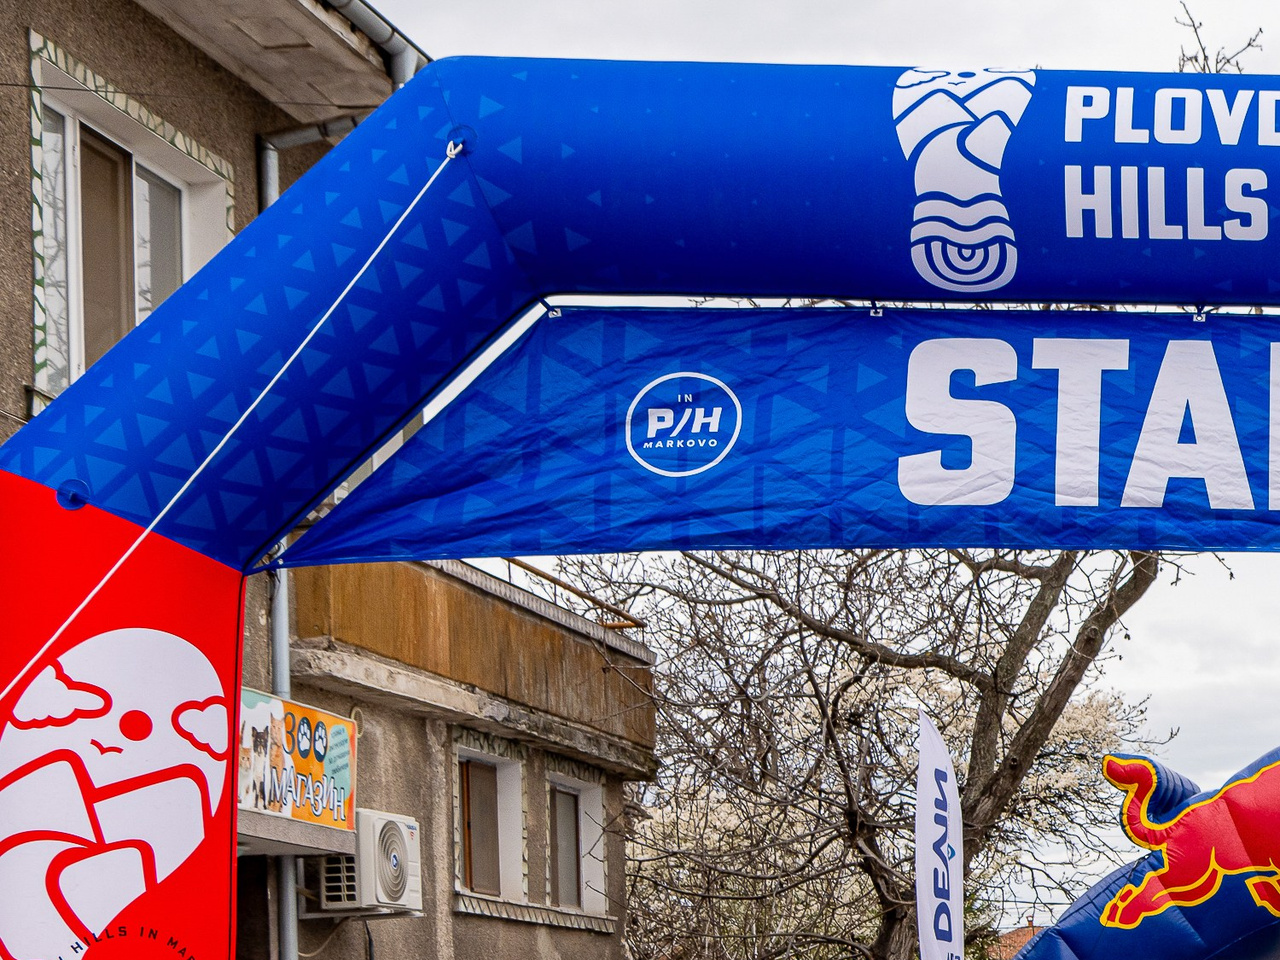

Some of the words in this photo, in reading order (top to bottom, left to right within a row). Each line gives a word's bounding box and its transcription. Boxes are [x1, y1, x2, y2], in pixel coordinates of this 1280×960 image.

[1064, 165, 1269, 242] HILLS
[677, 394, 693, 403] IN
[647, 407, 722, 438] P/H
[643, 439, 718, 449] MARKOVO
[270, 766, 347, 822] МАГАЗИН
[70, 926, 127, 954] HILLS
[140, 926, 159, 940] IN
